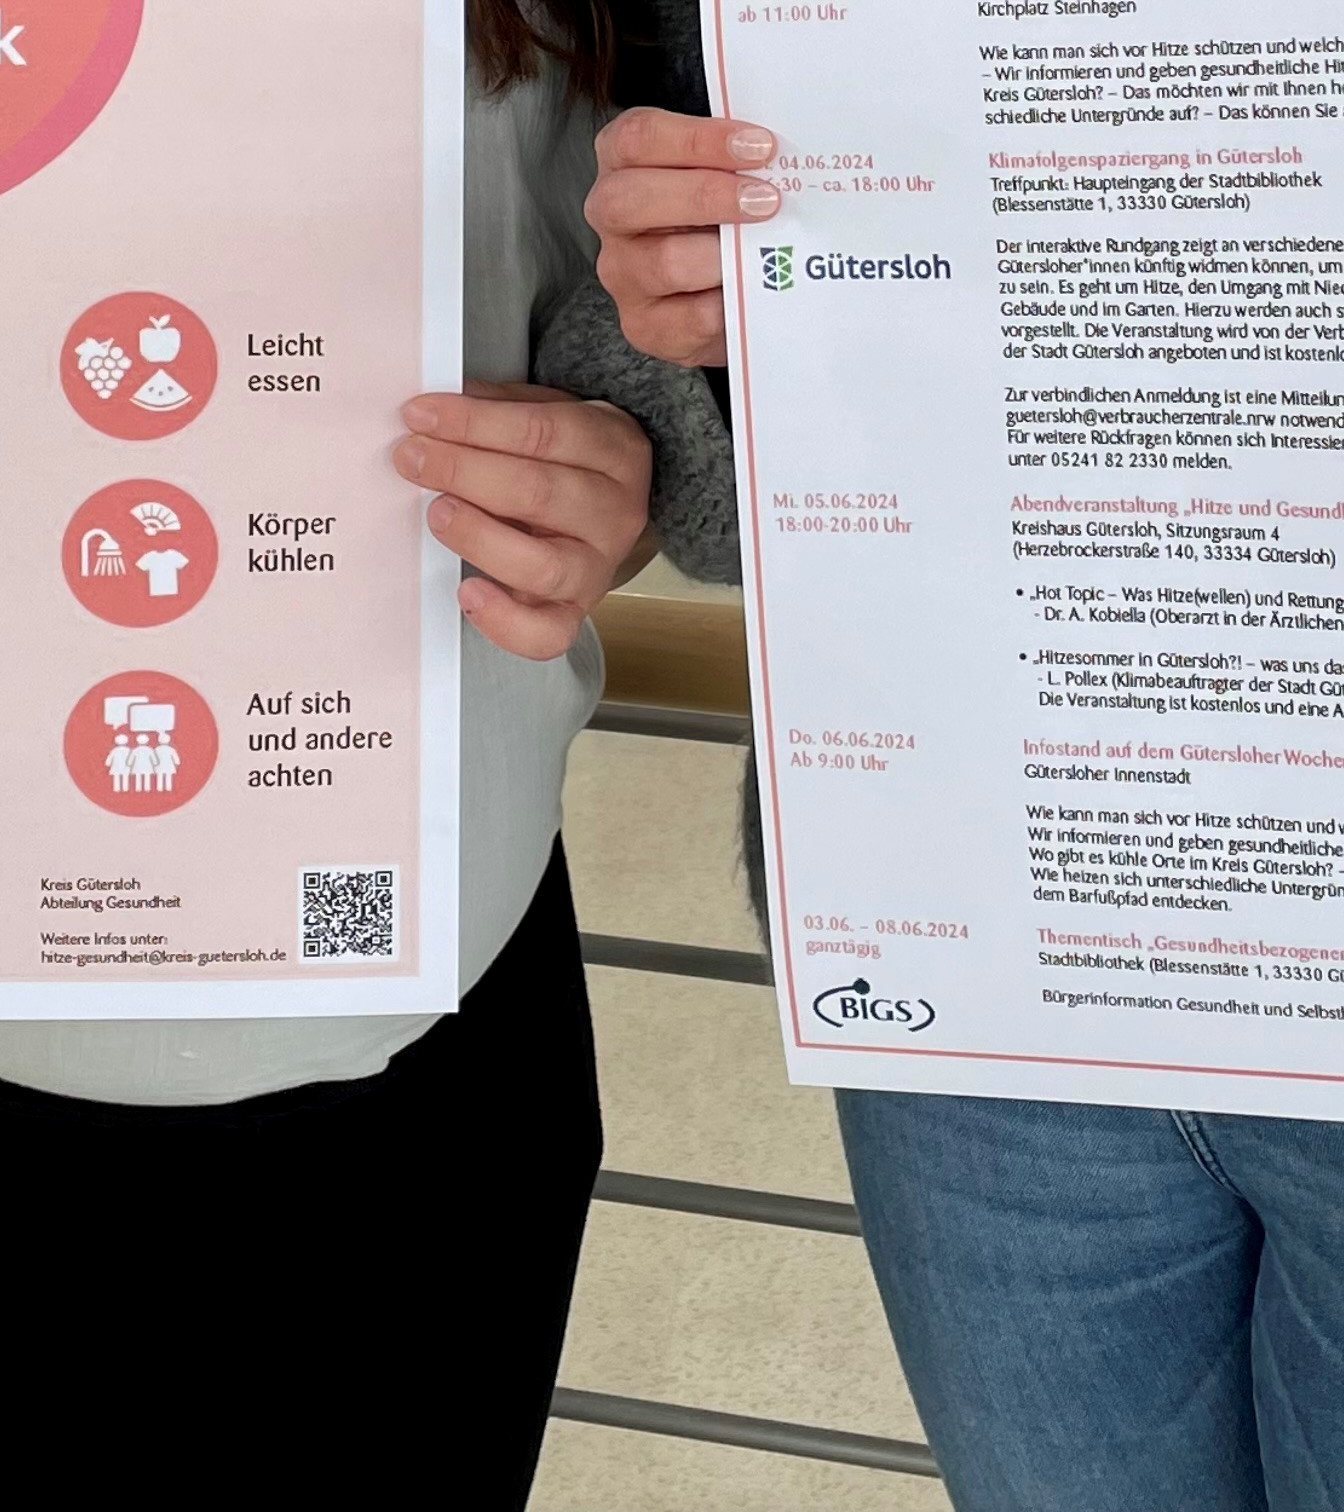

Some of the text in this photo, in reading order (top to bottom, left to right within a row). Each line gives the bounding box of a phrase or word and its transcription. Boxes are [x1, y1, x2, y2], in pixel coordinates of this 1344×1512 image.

[738, 3, 847, 23] ab 11:00 Uhr
[977, 0, 1049, 21] Kirchplatz
[778, 154, 874, 171] 04.06.2024
[988, 145, 1303, 172] Klimafolgenspaziergang in Gütersloh
[822, 180, 847, 192] ca.
[851, 176, 901, 192] 18:00
[906, 175, 936, 192] Uhr
[990, 171, 1323, 195] Treffpunkt: Haupteingang der Stadtbibliothek
[992, 192, 1251, 216] (Blessenstätte 1, 33330 Gütersloh)
[805, 252, 951, 280] Gütersloh
[248, 332, 324, 357] Leicht
[247, 374, 321, 393] essen
[1008, 451, 1232, 470] unter 05241 82 2330 melden.
[773, 492, 898, 510] Mi. 05.06.2024
[1010, 493, 1179, 519] Abendveranstaltung
[1238, 500, 1272, 517] und
[248, 513, 336, 542] Körper
[775, 515, 913, 534] 18:00-20:00 Uhr
[1011, 519, 1280, 544] Kreishaus Gütersloh, Sitzungsraum 4
[248, 547, 334, 573] kühlen
[1012, 540, 1336, 570] (Herzebrockerstraße 140, 33334 Gütersloh)
[246, 690, 351, 716] Auf sich
[249, 725, 392, 752] und andere
[788, 728, 915, 750] Do. 06.06.2024
[790, 750, 889, 771] Ab 9:00 Uhr
[1023, 738, 1101, 758] Infostand
[1106, 741, 1132, 759] auf
[1137, 741, 1174, 760] dem
[1179, 744, 1282, 765] Gütersloher
[248, 763, 332, 788] achten
[1023, 763, 1191, 785] Gütersloher Innenstadt
[41, 877, 141, 891] Kreis Gütersloh
[39, 895, 182, 913] Abteilung Gesundheit
[1033, 885, 1232, 912] dem Barfußpfad entdecken.
[40, 931, 168, 946] Weitere Infos unter:
[803, 915, 855, 932] 03.06.
[875, 919, 969, 939] 08.06.2024
[1037, 927, 1142, 949] Thementisch
[40, 948, 287, 968] hitze-gesundheit@kreis-guetersloh.de
[805, 939, 882, 960] ganztägig
[1038, 951, 1145, 971] Stadtbibliothek
[1149, 957, 1249, 977] (Blessenstätte
[1254, 964, 1269, 981] 1,
[1272, 965, 1323, 982] 33330
[840, 997, 913, 1023] BIGS
[1042, 988, 1173, 1010] Bürgerinformation
[1176, 997, 1260, 1016] Gesundheit
[1263, 1002, 1293, 1017] und
